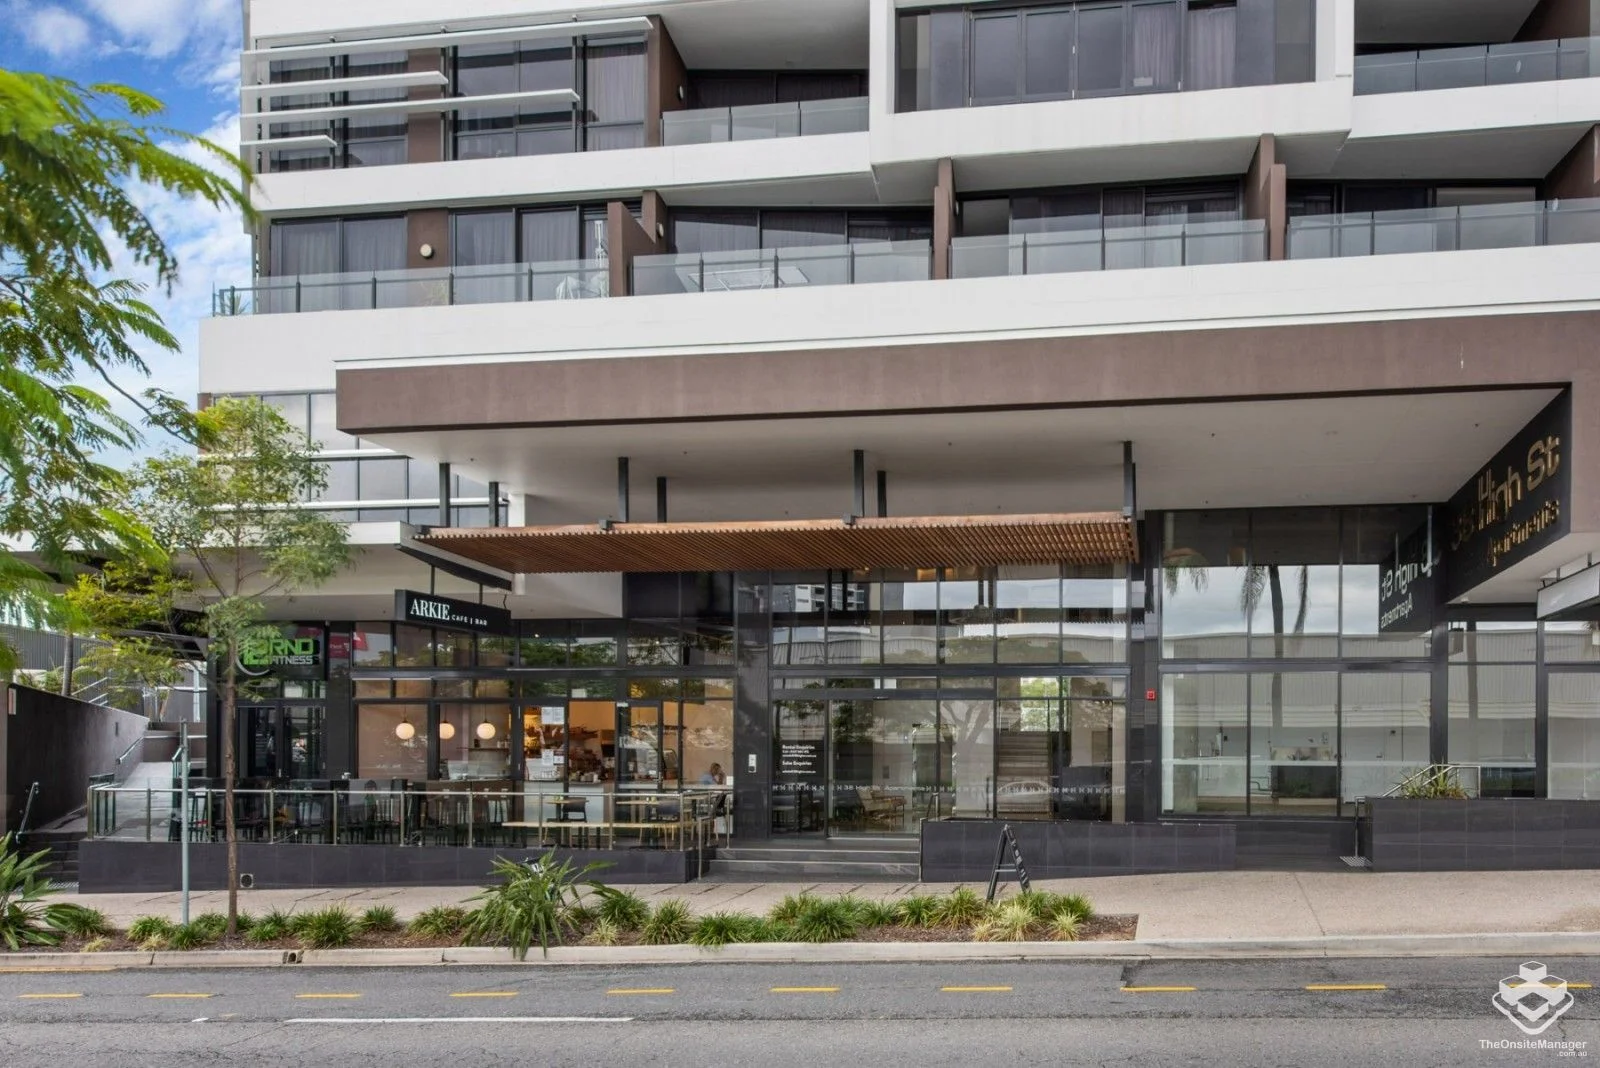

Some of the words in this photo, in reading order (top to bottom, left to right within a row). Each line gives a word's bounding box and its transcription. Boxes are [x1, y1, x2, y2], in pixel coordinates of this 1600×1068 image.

[1526, 435, 1560, 492] St
[410, 598, 450, 621] ARKIE
[451, 613, 468, 623] CAFE
[475, 618, 488, 626] BAR
